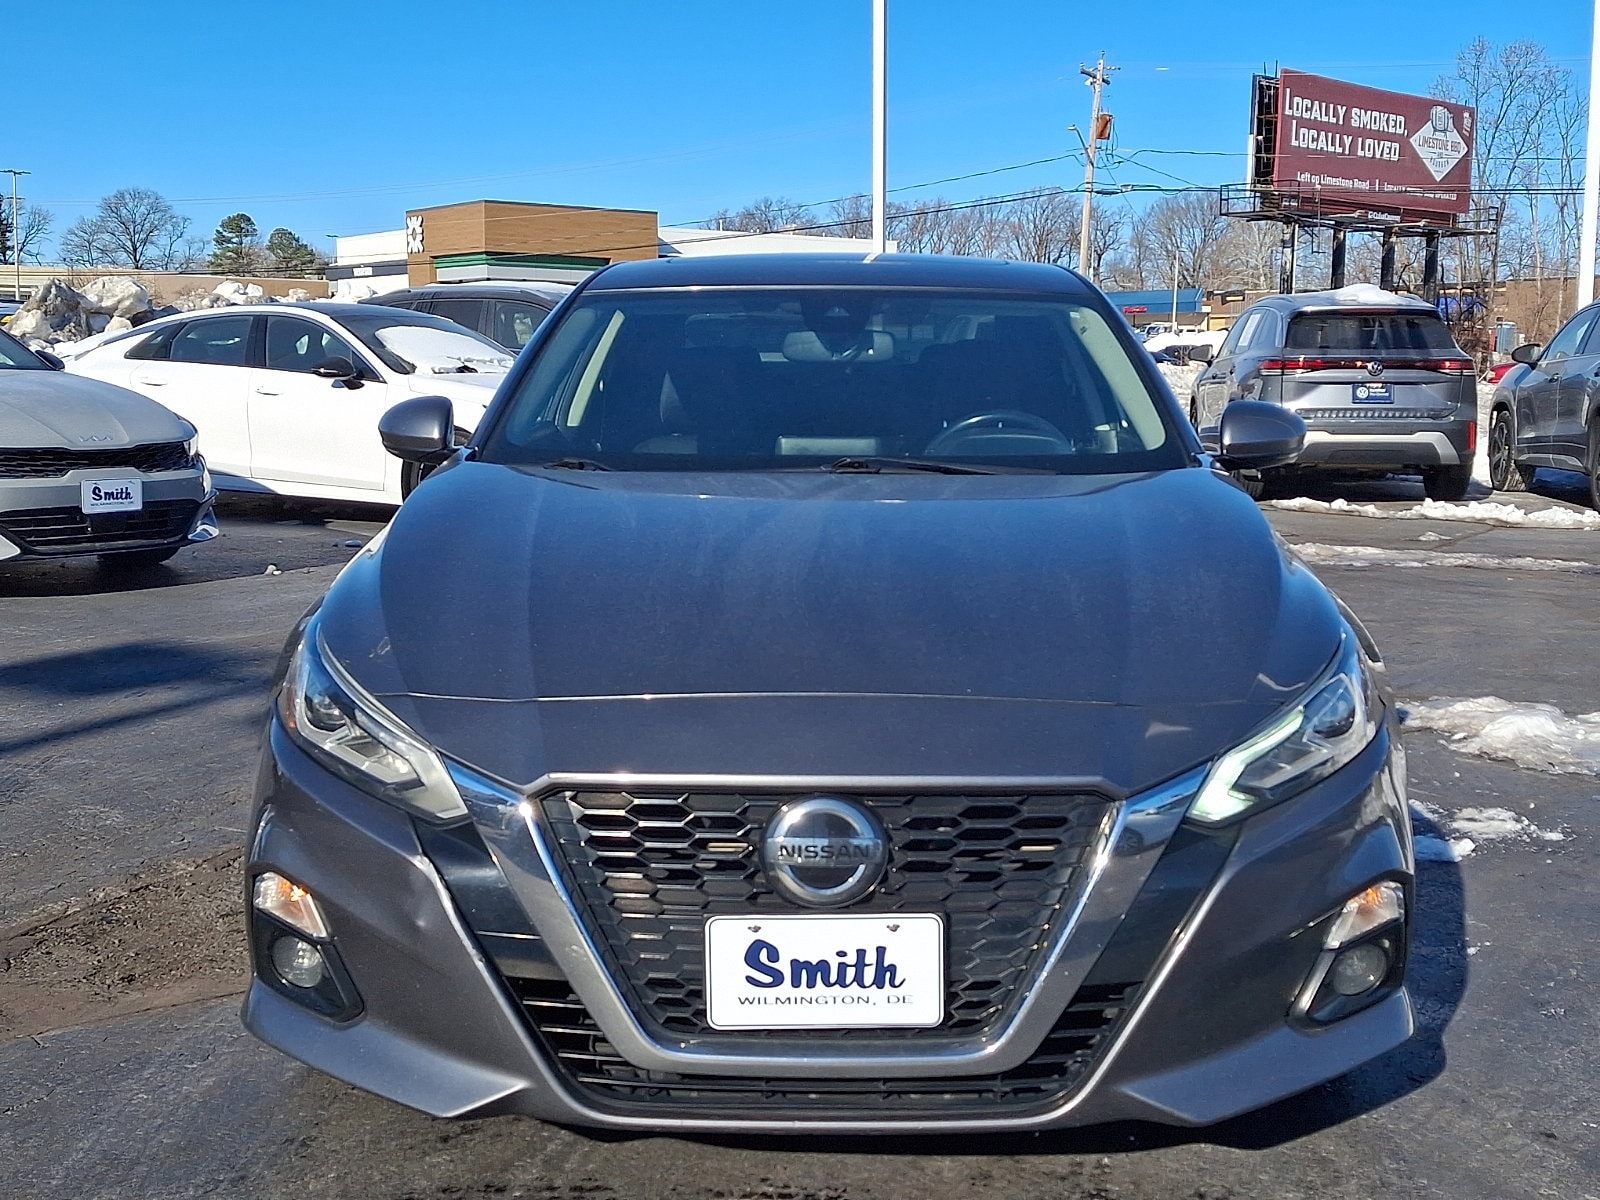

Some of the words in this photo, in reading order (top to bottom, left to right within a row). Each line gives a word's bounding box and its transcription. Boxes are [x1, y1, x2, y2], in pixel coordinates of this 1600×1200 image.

[1284, 88, 1347, 125] LOCALLY
[1351, 108, 1408, 137] SMOKED,
[1291, 120, 1353, 155] LOCALLY
[1357, 137, 1400, 161] LOVED
[1418, 135, 1449, 151] LIMESTONE
[1297, 171, 1311, 183] Left
[1320, 174, 1353, 187] Limestone
[1353, 178, 1370, 189] Road
[91, 486, 134, 501] Smith
[779, 843, 870, 860] NISSAN
[743, 939, 906, 989] Smith
[738, 995, 877, 1006] WILMINGTON,
[886, 994, 914, 1005] DE
